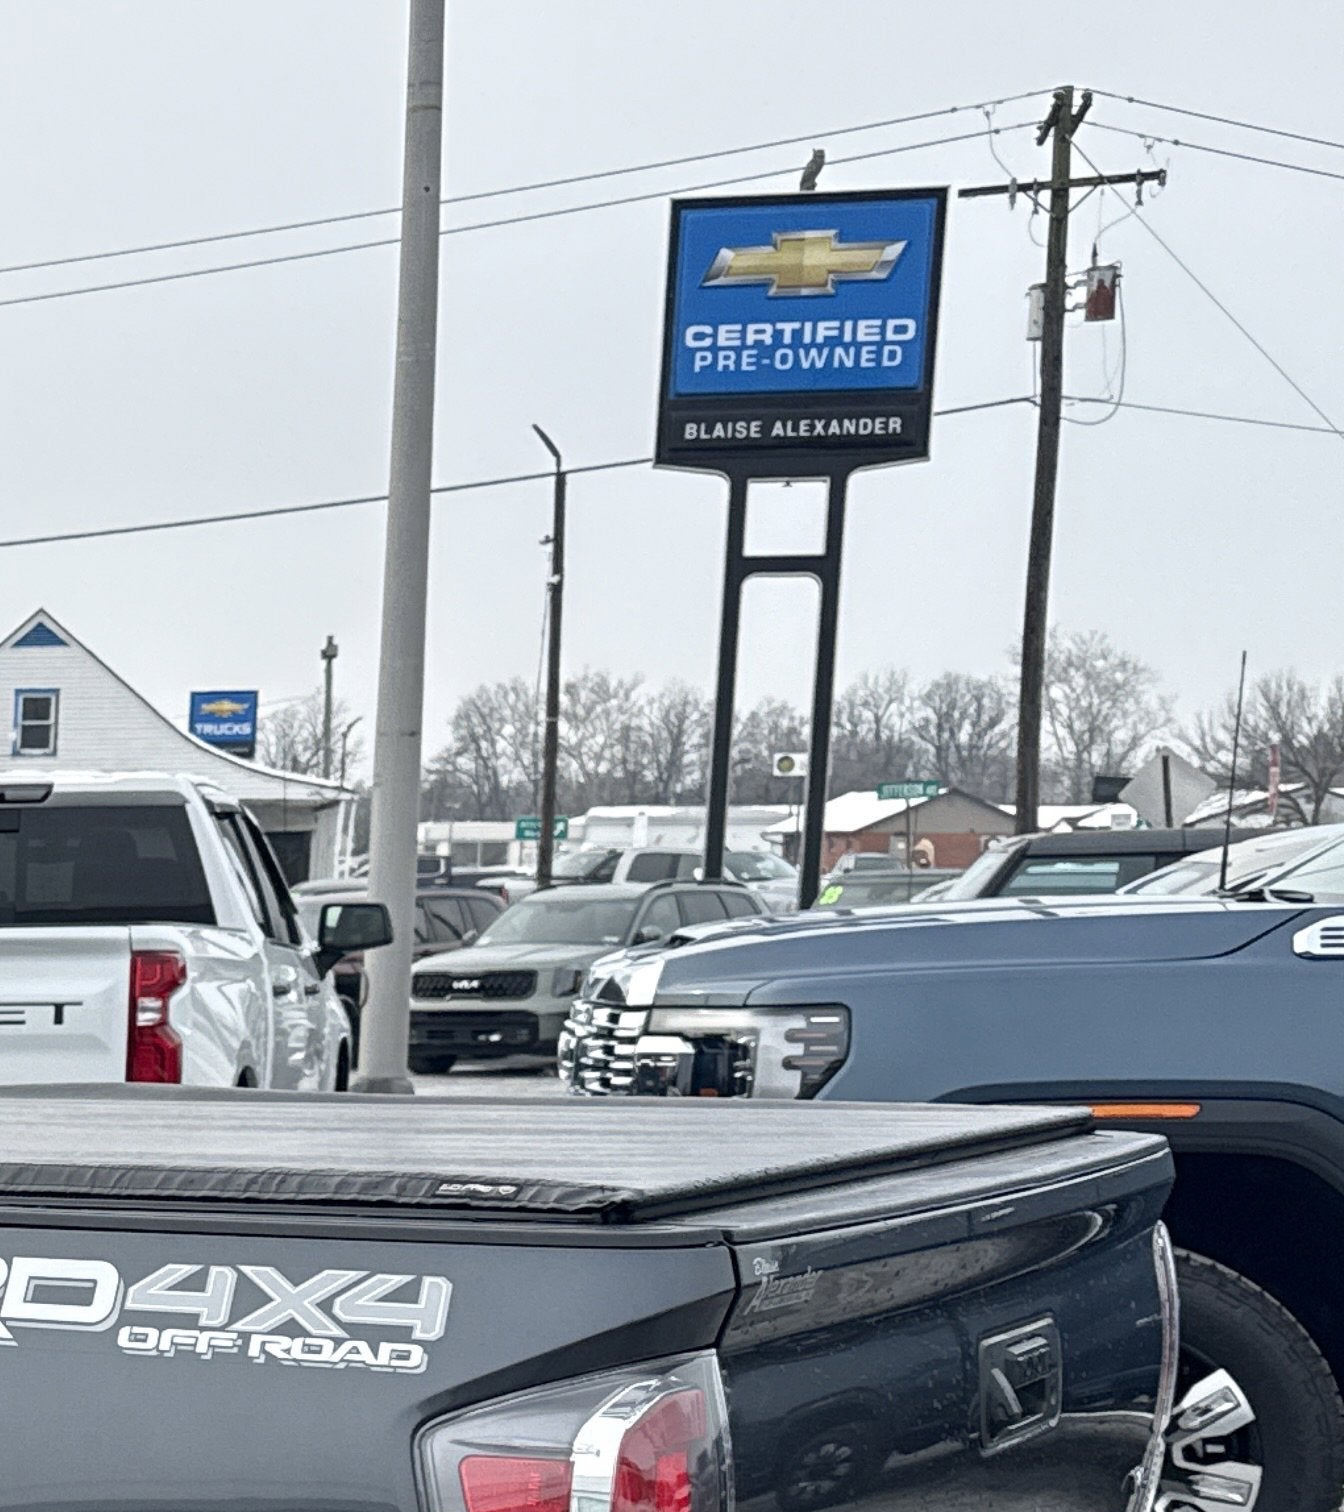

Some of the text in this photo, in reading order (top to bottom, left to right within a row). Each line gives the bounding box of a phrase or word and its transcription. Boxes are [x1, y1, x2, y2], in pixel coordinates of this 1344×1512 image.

[684, 318, 917, 348] CERTIFIED
[694, 345, 903, 373] PRE-OWNED
[684, 416, 902, 440] BLAISE ALEXANDER
[195, 722, 252, 736] TRUCKS
[123, 1263, 453, 1341] 4X4
[117, 1325, 429, 1374] OFF ROAD
